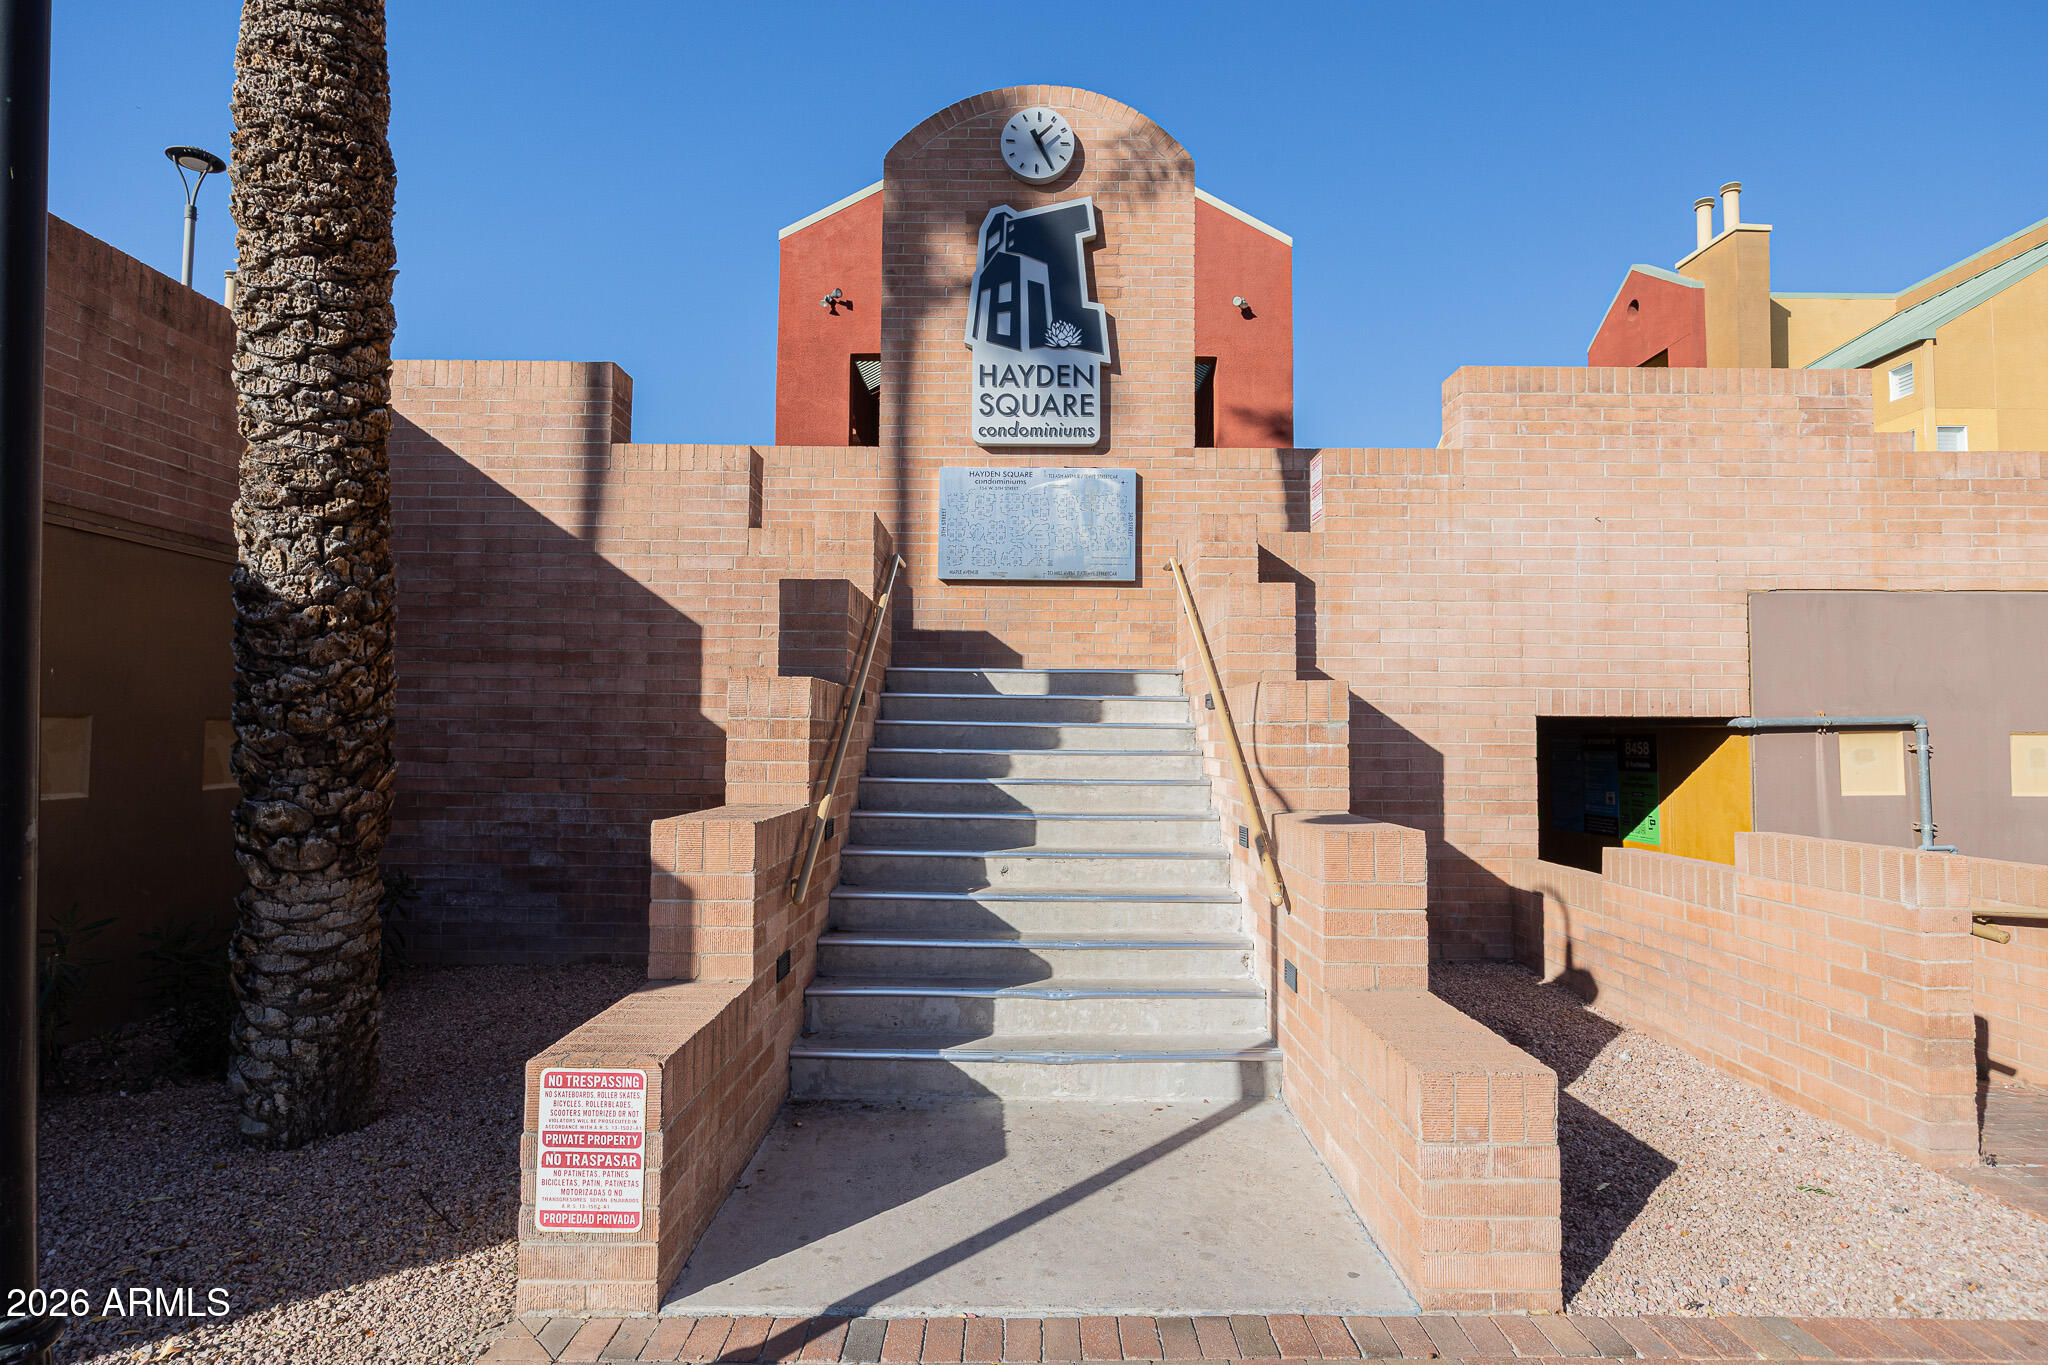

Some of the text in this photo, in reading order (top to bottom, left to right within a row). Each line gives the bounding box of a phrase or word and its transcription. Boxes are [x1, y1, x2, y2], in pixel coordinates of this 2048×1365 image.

[979, 364, 1094, 388] HAYDEN
[979, 393, 1094, 418] SQUARE
[978, 421, 1096, 438] condominiums
[1625, 742, 1649, 756] 8458
[548, 1075, 640, 1088] NO TRESPASSING
[545, 1134, 638, 1145] PRIVATE PROPERTY
[545, 1154, 637, 1167] NO TRASPASAR
[543, 1213, 635, 1224] PROPIEDAD PRIVADA
